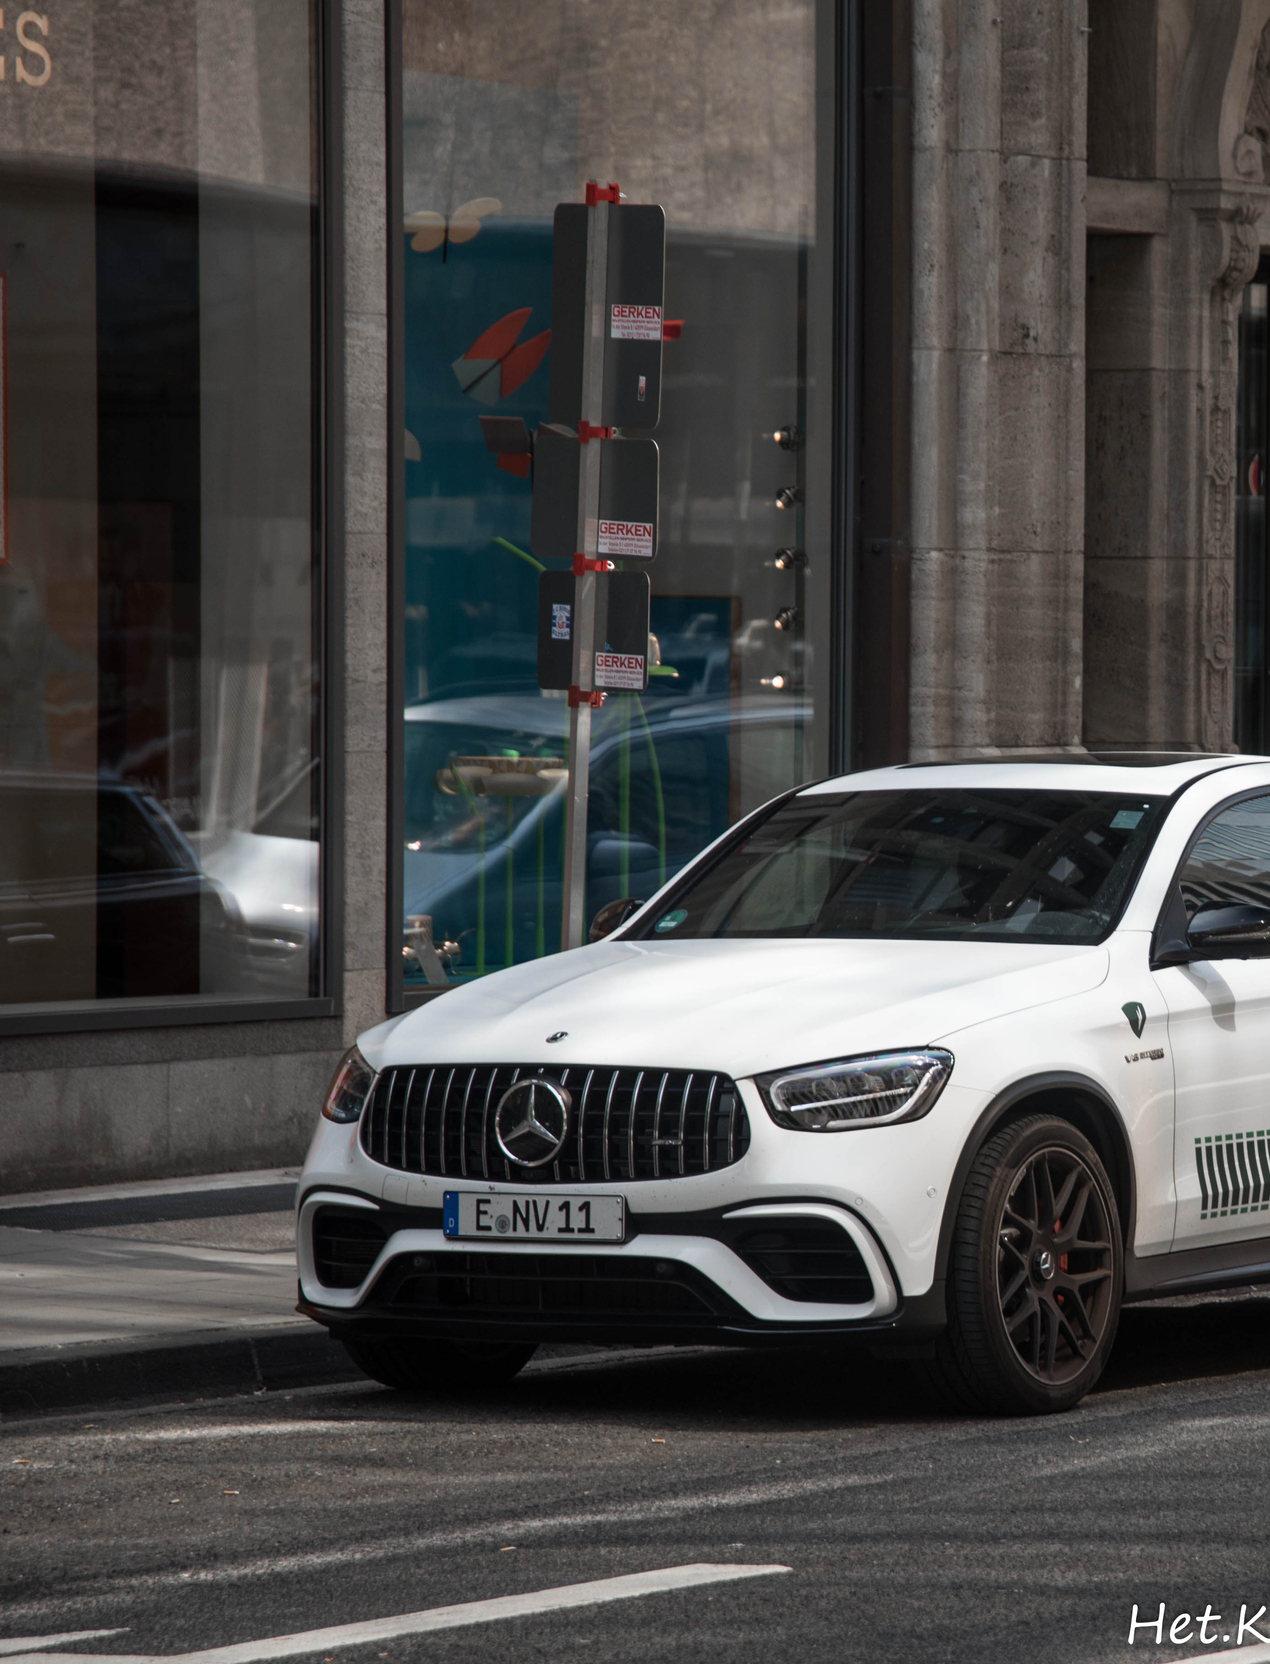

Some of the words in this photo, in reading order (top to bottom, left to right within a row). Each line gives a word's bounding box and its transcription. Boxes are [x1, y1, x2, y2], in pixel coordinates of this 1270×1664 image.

[0, 8, 52, 88] S
[612, 304, 660, 319] GERKEN
[600, 522, 651, 537] GERKEN
[596, 655, 642, 669] GERKEN
[448, 1217, 455, 1228] D
[475, 1198, 492, 1231] E
[512, 1199, 550, 1232] NV
[557, 1200, 596, 1234] 11
